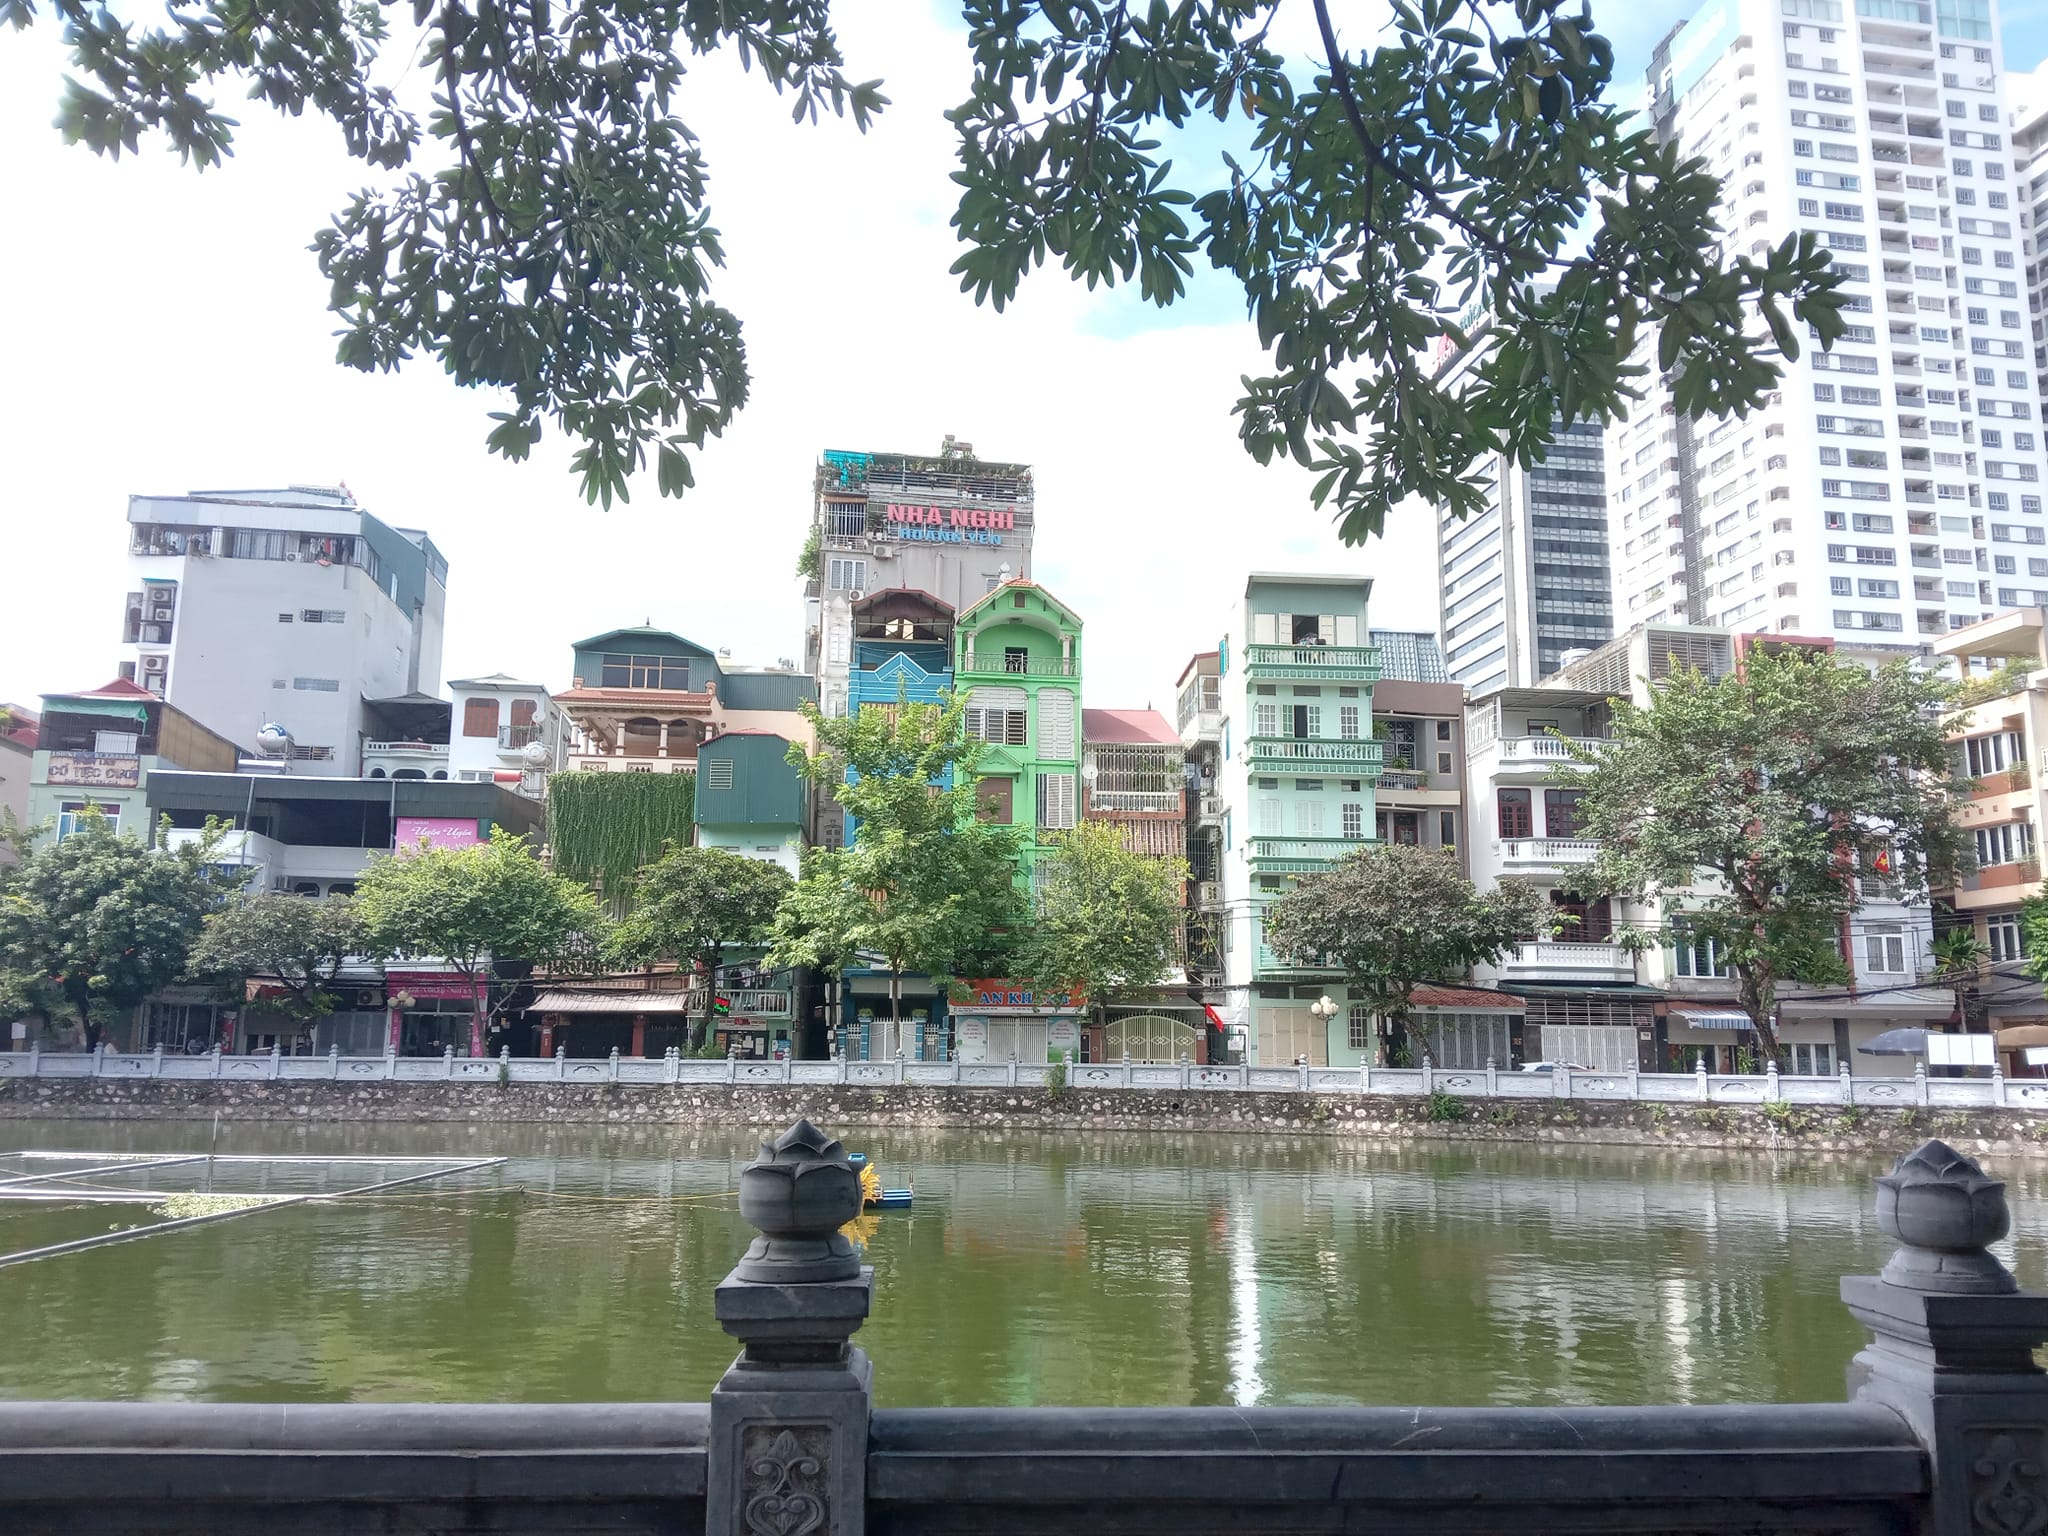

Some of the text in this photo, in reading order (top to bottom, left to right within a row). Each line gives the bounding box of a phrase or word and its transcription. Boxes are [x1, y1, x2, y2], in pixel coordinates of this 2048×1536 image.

[886, 502, 1014, 530] NHÀ NGHỈ
[978, 991, 1003, 1005] AN
